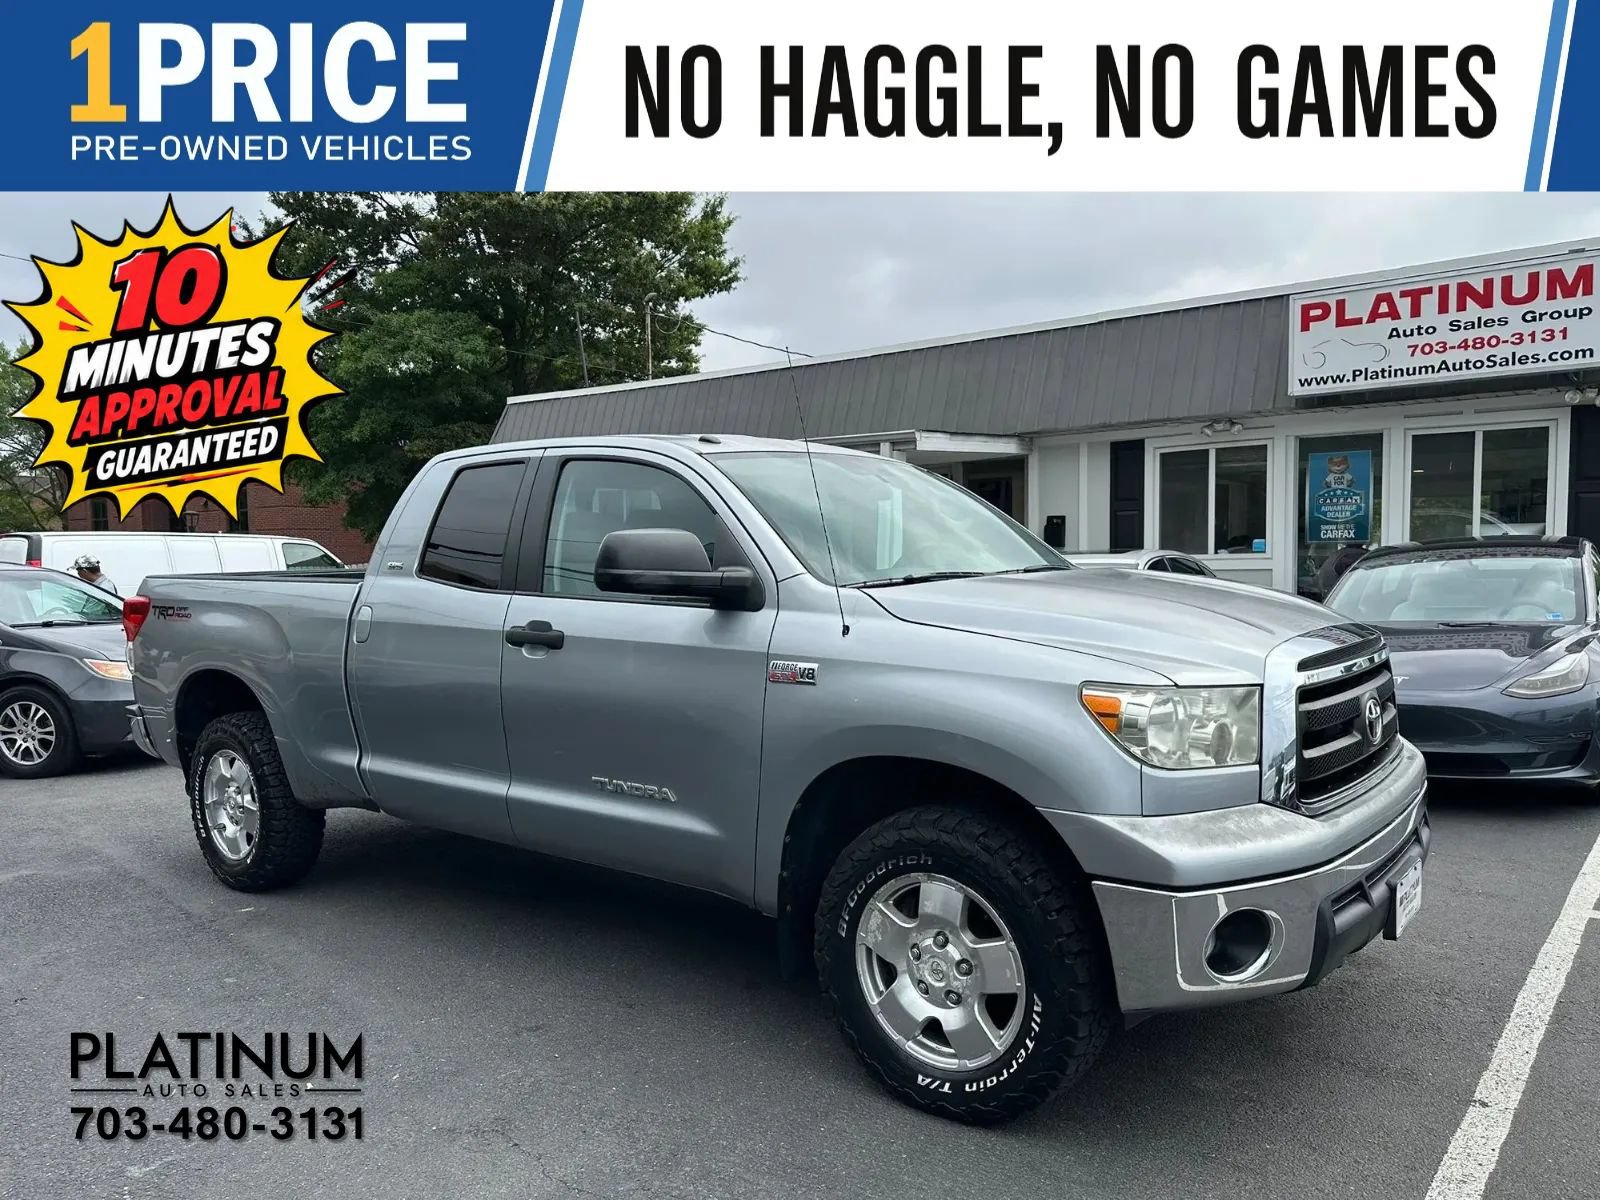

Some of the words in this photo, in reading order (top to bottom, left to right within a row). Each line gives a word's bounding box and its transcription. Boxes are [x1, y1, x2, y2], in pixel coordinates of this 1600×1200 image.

[1300, 263, 1594, 332] PLATINUM
[1387, 325, 1437, 340] Auto
[1448, 314, 1509, 332] Sales
[1521, 305, 1593, 324] Group
[1407, 326, 1569, 357] 703-480-3131
[1298, 346, 1594, 387] www.PlatinumAutoSales.com
[1320, 529, 1355, 539] CARFAX
[798, 667, 816, 680] V8
[591, 776, 678, 802] TUNDRA
[837, 853, 933, 938] BFGoodrich
[964, 992, 1044, 1093] All-Terrain
[916, 1073, 953, 1094] T/A
